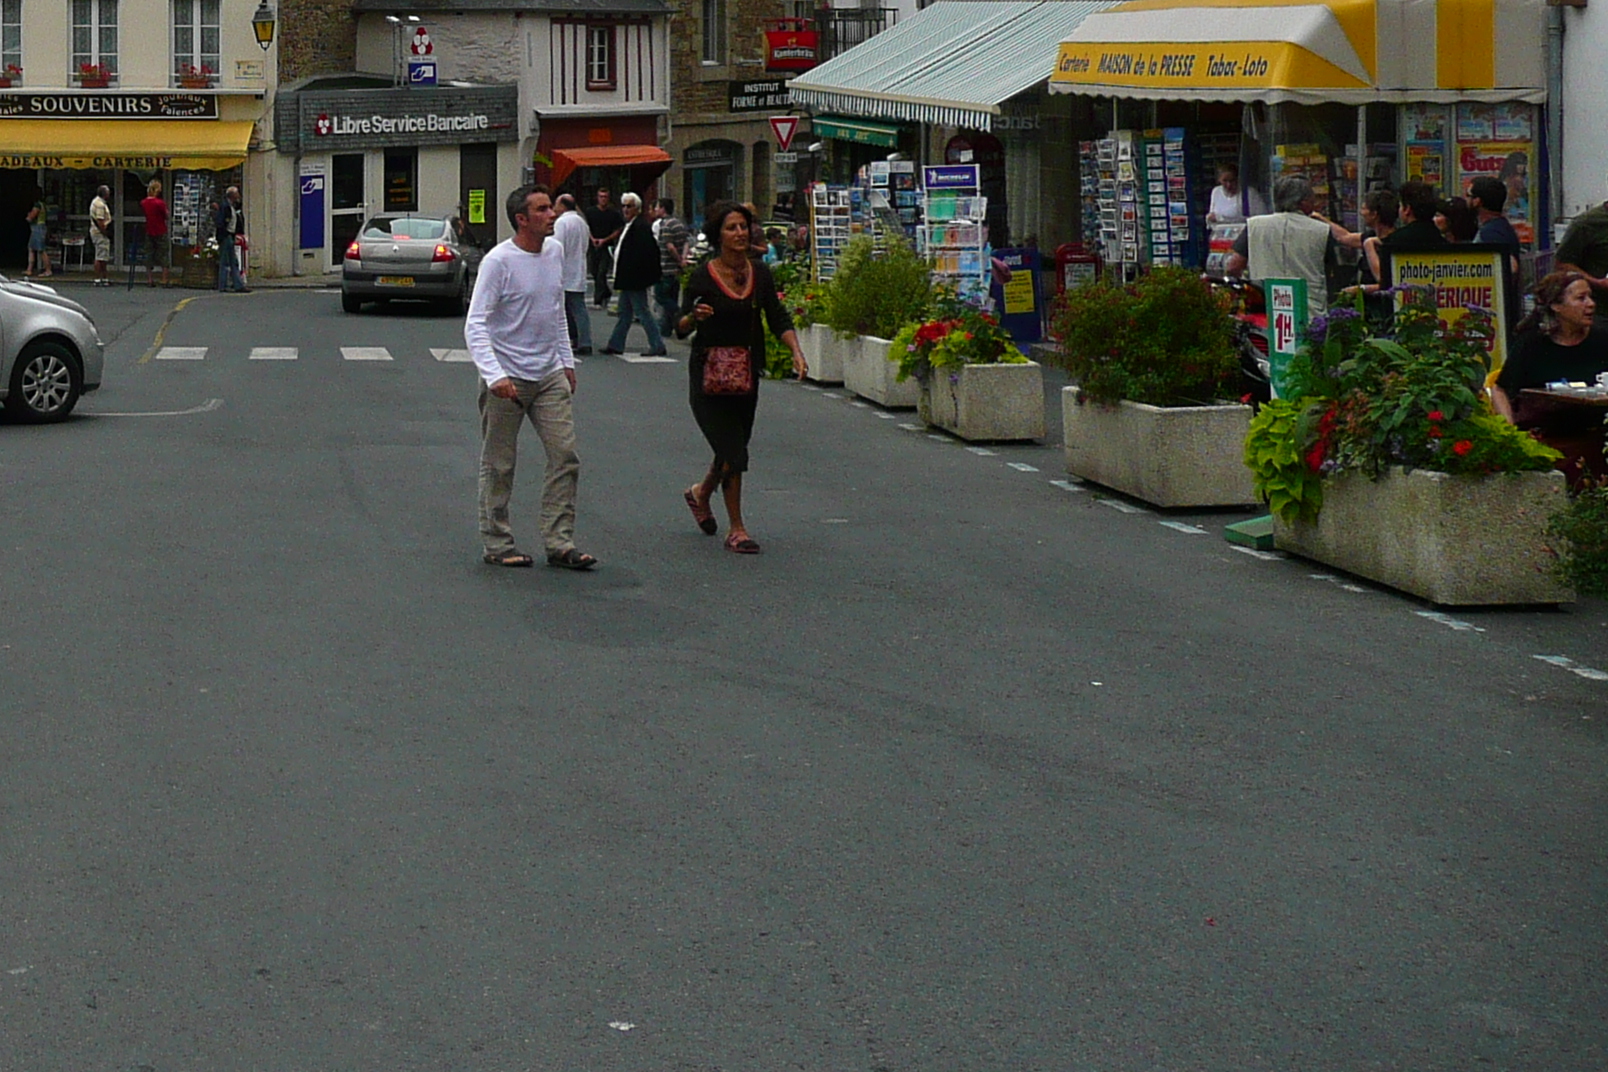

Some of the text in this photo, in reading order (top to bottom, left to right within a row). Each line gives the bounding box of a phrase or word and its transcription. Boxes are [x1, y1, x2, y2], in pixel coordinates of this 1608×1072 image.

[1059, 52, 1090, 73] Carterie
[1098, 52, 1132, 75] MAISON
[1133, 53, 1146, 75] de
[1149, 54, 1156, 76] la
[1160, 54, 1196, 77] PRESSE
[744, 82, 780, 94] INSTITUT
[30, 96, 152, 113] SOUVENIRS
[732, 95, 757, 108] FORME
[333, 112, 489, 134] Libre Service Bancaire
[93, 156, 172, 168] CARTERIE
[1399, 260, 1493, 282] photo-janvier.com
[1273, 288, 1292, 307] Photo
[1402, 282, 1492, 308] NÉRIQUE
